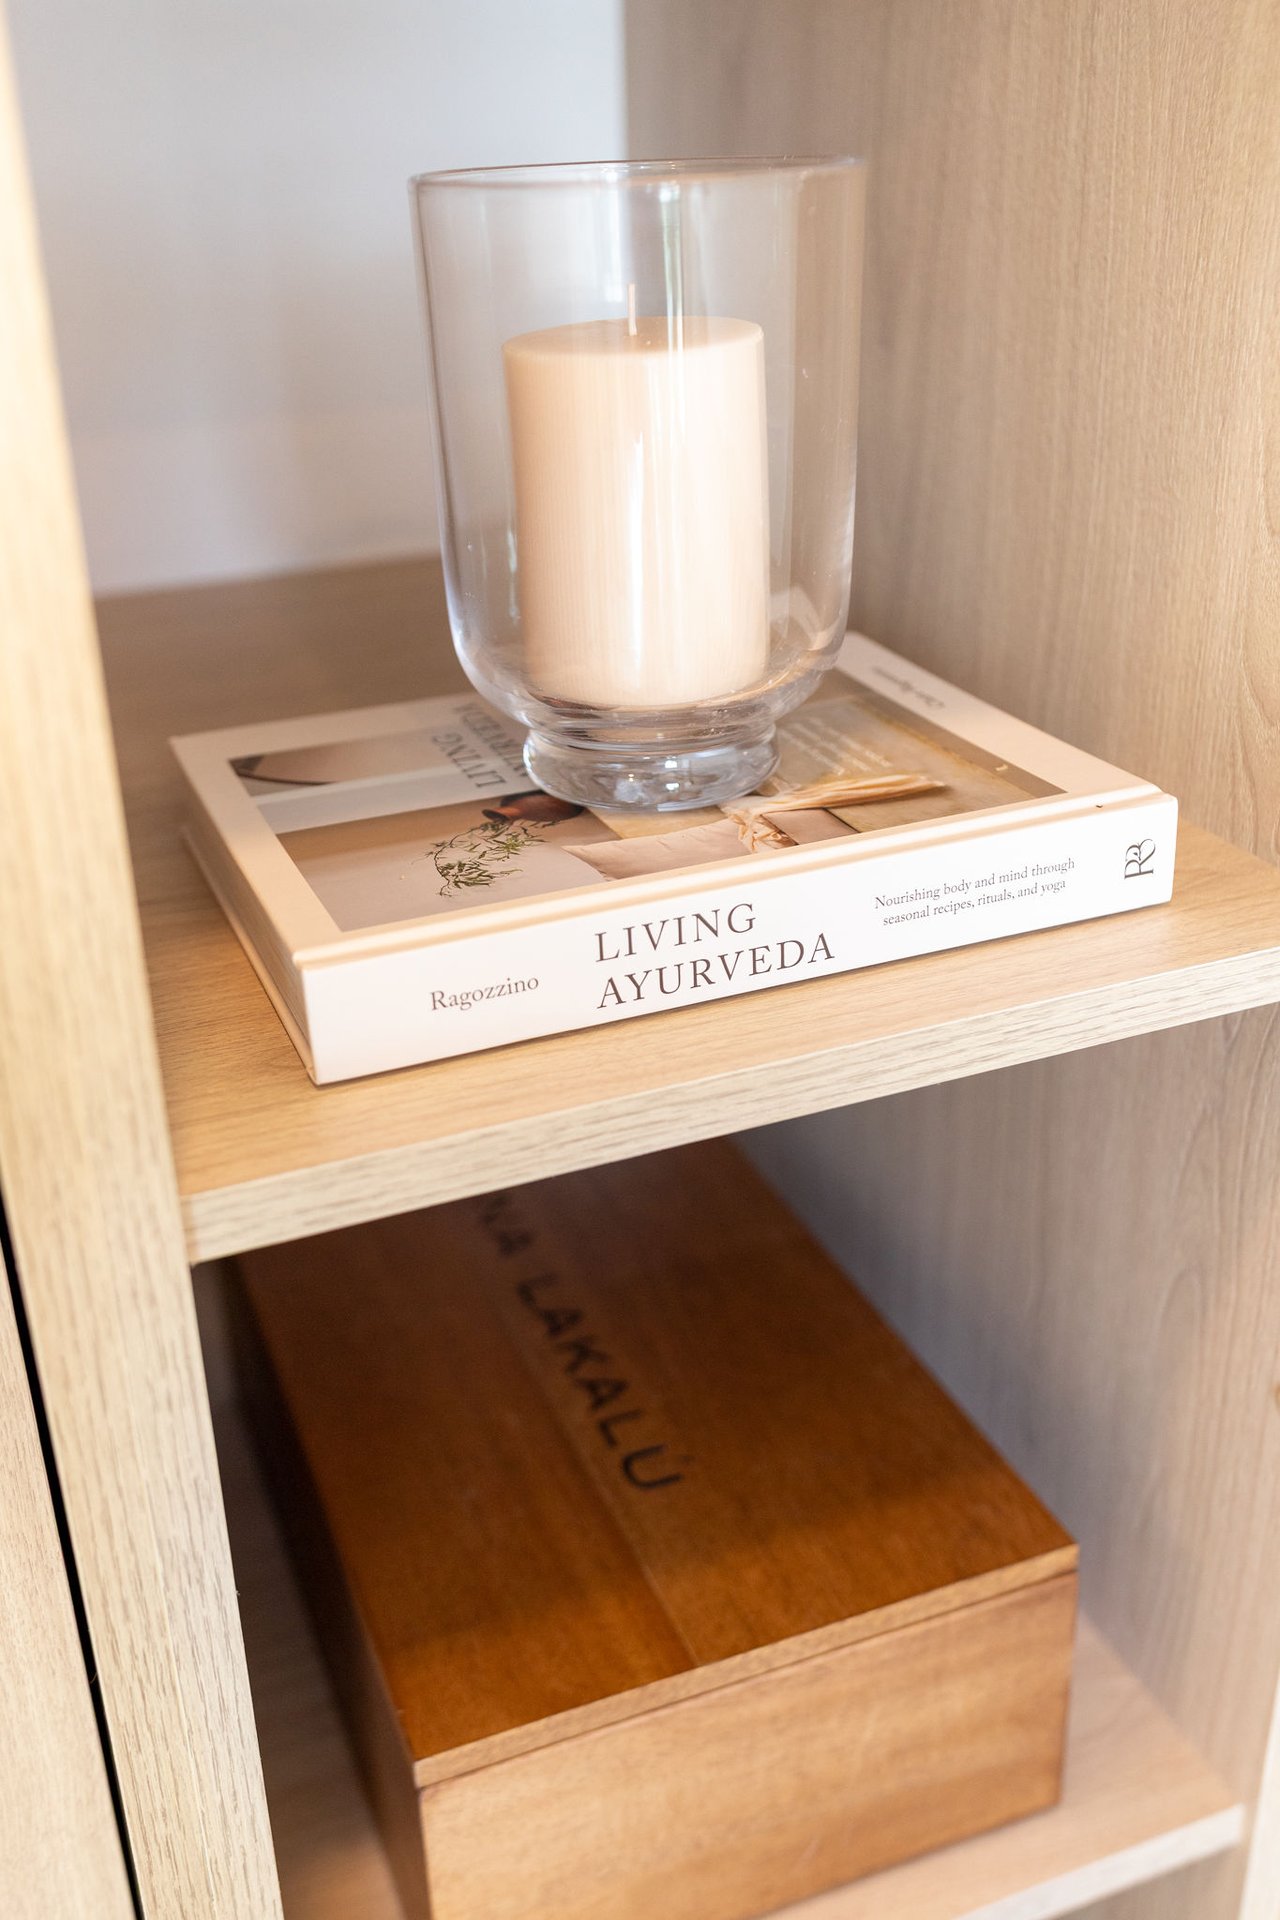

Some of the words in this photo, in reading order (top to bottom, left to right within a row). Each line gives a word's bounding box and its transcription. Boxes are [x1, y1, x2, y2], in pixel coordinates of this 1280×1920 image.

[431, 731, 507, 789] LIVING
[874, 887, 941, 910] Nourishing
[943, 878, 972, 895] body
[974, 873, 996, 889] and
[998, 866, 1028, 884] mind
[1031, 857, 1075, 877] through
[883, 905, 930, 926] seasonal
[933, 898, 975, 916] recipes,
[977, 888, 1016, 906] rituals,
[1017, 882, 1038, 898] and
[1040, 878, 1066, 898] yoga
[595, 903, 757, 962] LIVING
[430, 976, 539, 1011] Ragozzino
[596, 932, 836, 1009] AYURVEDA
